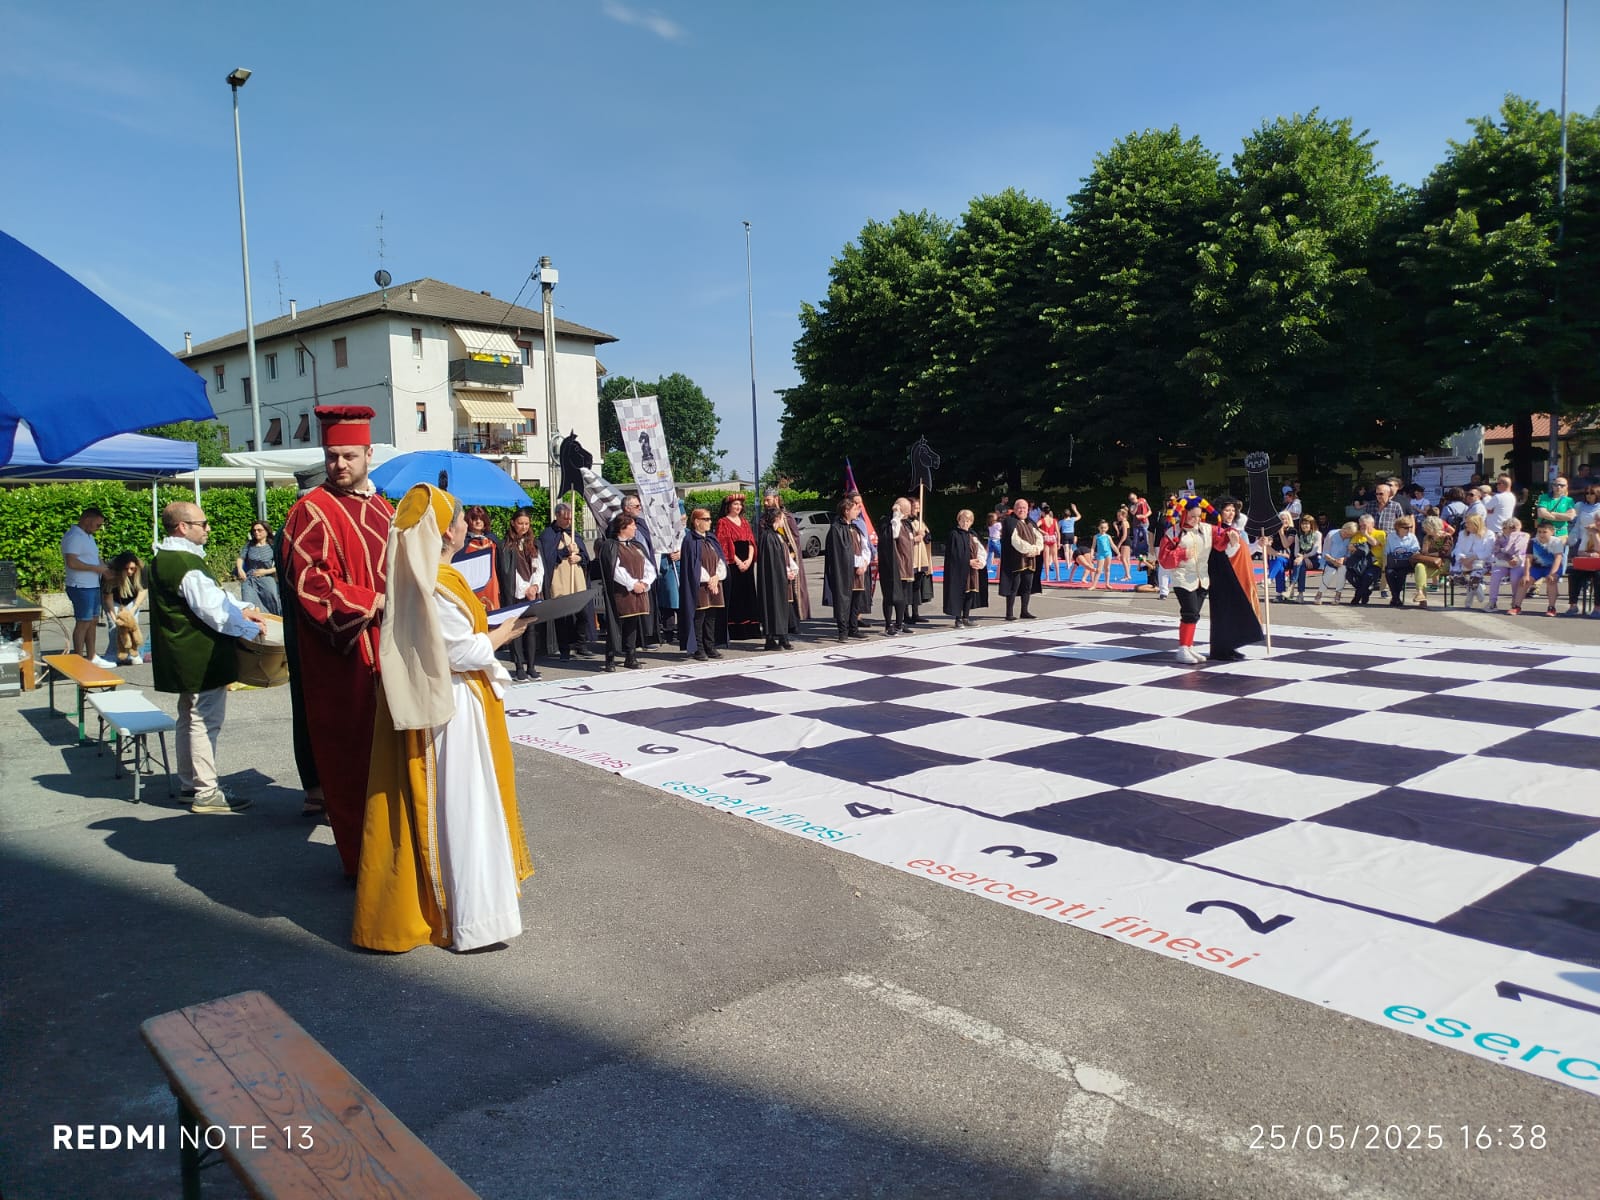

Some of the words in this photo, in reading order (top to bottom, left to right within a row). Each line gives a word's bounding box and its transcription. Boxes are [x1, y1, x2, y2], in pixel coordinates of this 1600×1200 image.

[505, 708, 537, 718] 8
[558, 723, 590, 735] 7
[637, 743, 679, 755] 6
[723, 769, 772, 786] 5
[844, 802, 896, 819] 4
[768, 813, 862, 842] finesi
[980, 845, 1058, 869] 3
[906, 858, 1105, 920] esercenti
[1100, 915, 1261, 969] finesi
[1186, 900, 1296, 935] 2
[1494, 980, 1600, 1016] 1
[1383, 1004, 1600, 1081] eserc
